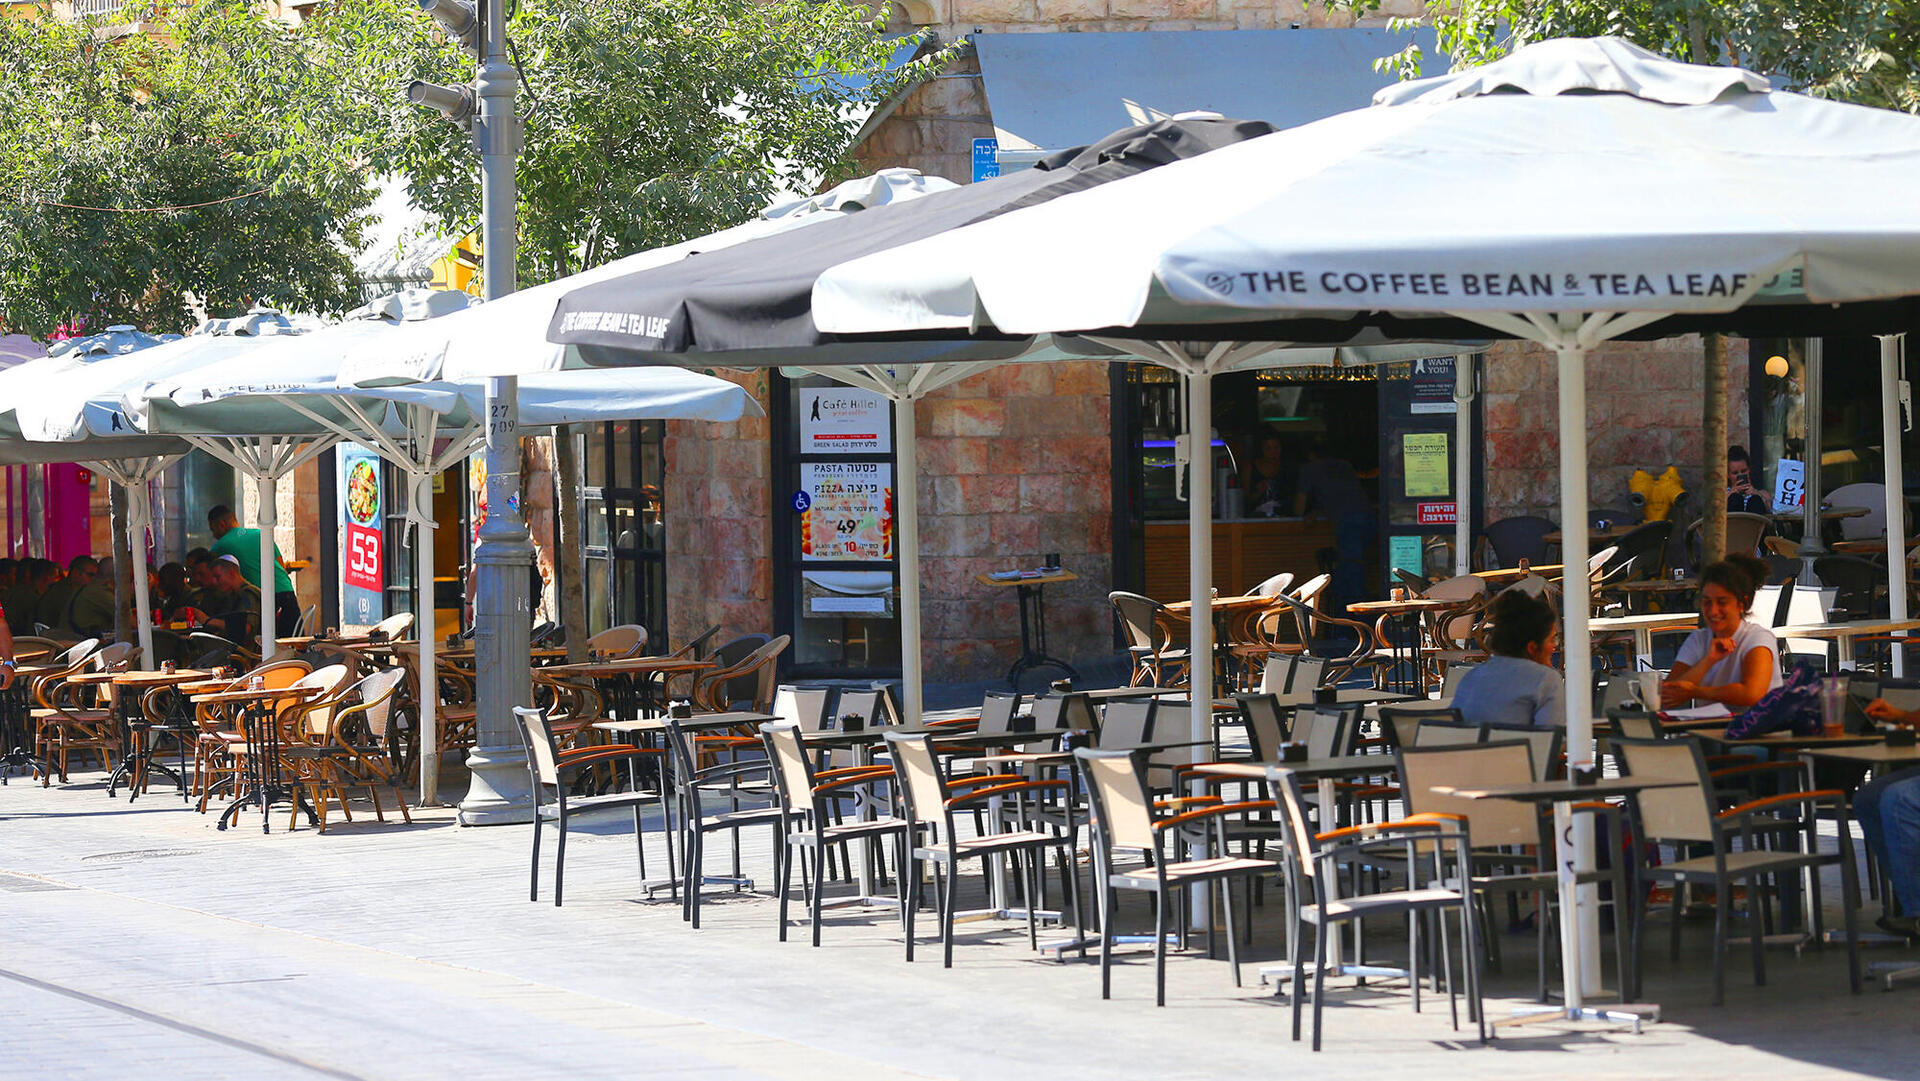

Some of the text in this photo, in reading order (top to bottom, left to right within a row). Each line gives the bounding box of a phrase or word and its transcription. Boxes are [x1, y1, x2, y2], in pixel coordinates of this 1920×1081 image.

[975, 141, 998, 155] לכה
[1240, 271, 1307, 293] THE
[1321, 272, 1449, 295] COFFEE
[1461, 273, 1553, 297] BEAN
[1563, 274, 1585, 294] &
[1589, 273, 1656, 296] TEA
[1667, 273, 1748, 297] LEAF
[598, 312, 623, 333] BEAN
[628, 313, 645, 336] TEA
[646, 316, 671, 339] LEAF
[1427, 358, 1454, 366] WANT
[1428, 366, 1449, 374] YOU!
[823, 399, 877, 410] Café Hillel
[491, 405, 509, 418] 27
[490, 420, 515, 436] 709
[814, 464, 843, 472] PASTA
[847, 464, 877, 473] פסטה
[814, 485, 844, 493] PIZZA
[847, 484, 878, 493] פיצה
[1424, 504, 1455, 513] זהירות
[1422, 513, 1457, 522] מדרגה!
[837, 519, 856, 534] 49
[844, 541, 857, 552] 10
[350, 530, 378, 576] 53
